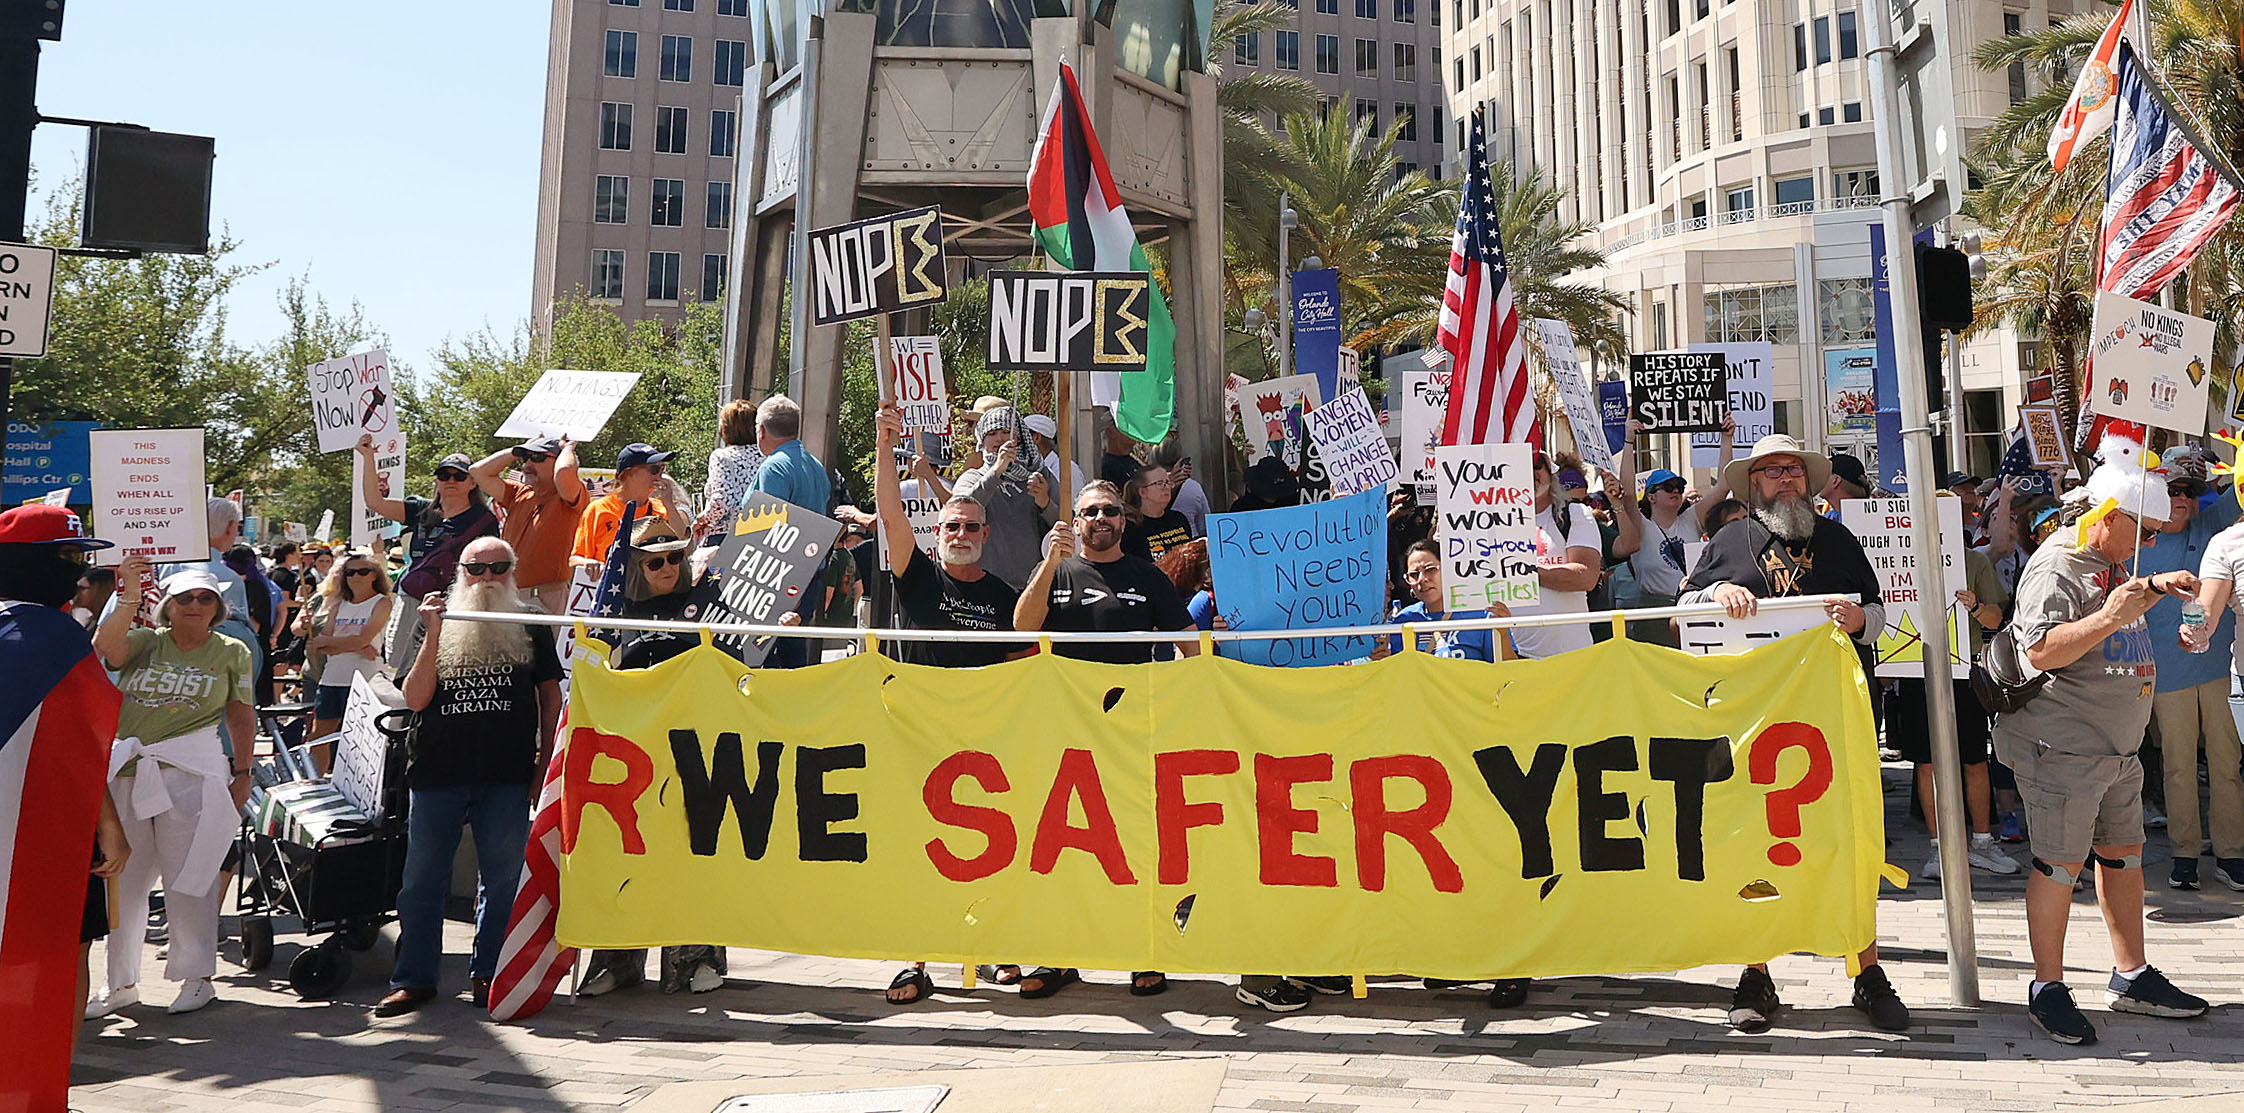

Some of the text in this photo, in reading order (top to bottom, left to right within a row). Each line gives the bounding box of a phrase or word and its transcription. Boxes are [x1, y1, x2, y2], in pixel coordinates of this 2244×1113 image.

[0, 254, 19, 274] O
[813, 210, 943, 319] NOPE
[0, 283, 31, 299] RN
[1298, 297, 1330, 310] Orlando
[990, 278, 1148, 364] NOPE
[1300, 307, 1335, 324] City Hall
[2141, 310, 2184, 338] NO KINGS
[2097, 316, 2137, 356] IMPECH
[2164, 334, 2182, 349] ILLEGAL
[895, 338, 915, 352] WE
[2154, 342, 2168, 355] WARS
[1340, 351, 1357, 375] TR
[1645, 354, 1712, 370] HISTORY
[1962, 354, 1980, 368] LL
[315, 355, 385, 395] Stop War
[891, 352, 939, 401] ISE
[1634, 368, 1721, 387] REPEATS IF
[1725, 359, 1761, 380] ON'T
[540, 376, 635, 398] NO KINGS!
[1647, 384, 1712, 401] WE STAY
[1313, 388, 1363, 431] ANGRY
[1728, 391, 1766, 412] END
[317, 399, 354, 431] Now
[517, 408, 538, 422] NO
[902, 405, 942, 426] GETHER
[1640, 400, 1727, 429] SILENT
[1313, 407, 1373, 447] WOMEN
[1692, 425, 1772, 444] PEDOILES!
[6, 441, 51, 451] ospital
[133, 442, 156, 450] THIS
[1337, 435, 1363, 452] WILL
[2039, 446, 2060, 457] 1776
[4, 458, 31, 467] Hall
[120, 457, 171, 465] MADNESS
[377, 456, 400, 470] KINGS
[1330, 437, 1389, 477] CHANGE
[2, 474, 38, 485] illips
[42, 474, 62, 484] Ctr
[129, 474, 159, 483] ENDS
[1344, 460, 1396, 494] WORLD
[1414, 469, 1437, 481] Kin
[117, 490, 174, 499] WHEN ALL
[1469, 487, 1533, 506] WARS
[111, 507, 184, 516] OF US RISE UP
[1864, 500, 1878, 513] NO
[123, 520, 171, 530] AND SAY
[1885, 516, 1912, 529] BIG
[141, 536, 153, 545] NO
[762, 520, 799, 553] NO
[1856, 535, 1911, 548] OUGH TO
[158, 546, 176, 555] WAY
[732, 544, 794, 591] FAUX
[1537, 556, 1563, 565] SALE
[1875, 556, 1895, 569] THE
[1890, 572, 1912, 588] I'M
[719, 576, 776, 621] KING
[1882, 589, 1918, 603] HERE
[447, 664, 513, 678] MEXICO
[126, 669, 219, 698] RESIST
[444, 676, 512, 691] PANAMA
[455, 688, 499, 701] GAZA
[441, 700, 512, 716] UKRAINE
[560, 721, 1833, 893] R WE SAFER YET?
